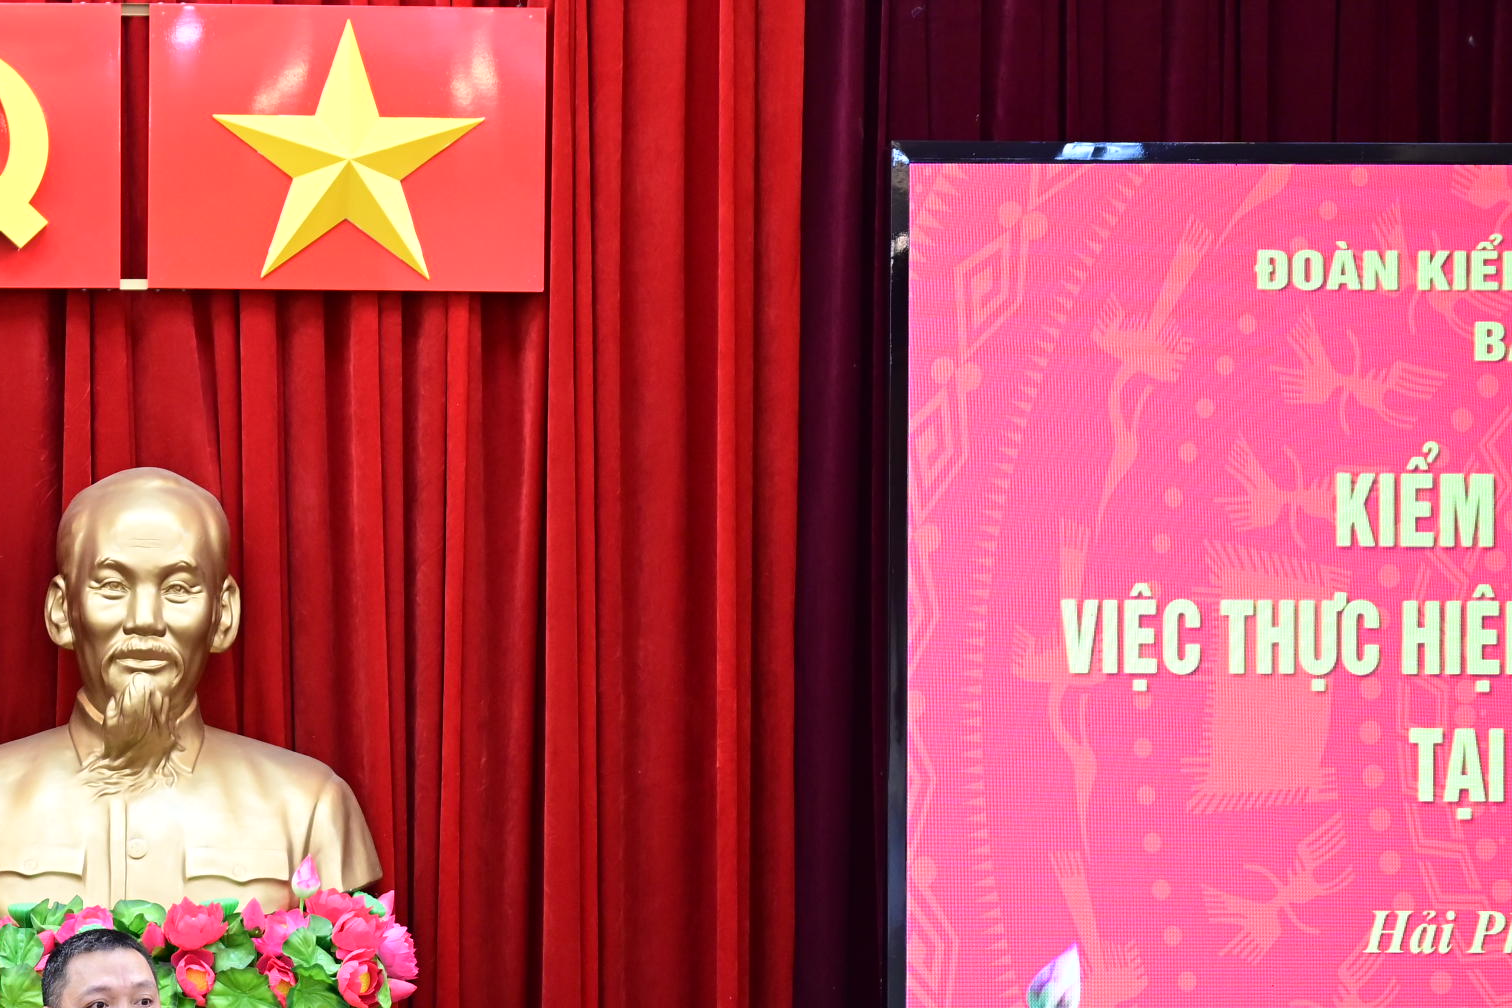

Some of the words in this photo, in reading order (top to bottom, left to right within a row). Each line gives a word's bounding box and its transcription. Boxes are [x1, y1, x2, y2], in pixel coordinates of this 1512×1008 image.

[1254, 241, 1400, 291] ĐOÀN
[1417, 233, 1512, 291] KIỂ
[1335, 441, 1496, 549] KIỂM
[1061, 583, 1201, 692] VIỆC
[1220, 592, 1381, 692] THỰC
[1402, 584, 1512, 693] HIỆ
[1408, 727, 1505, 820] TẠI
[1363, 911, 1456, 954] Hải
[1465, 911, 1512, 954] P
